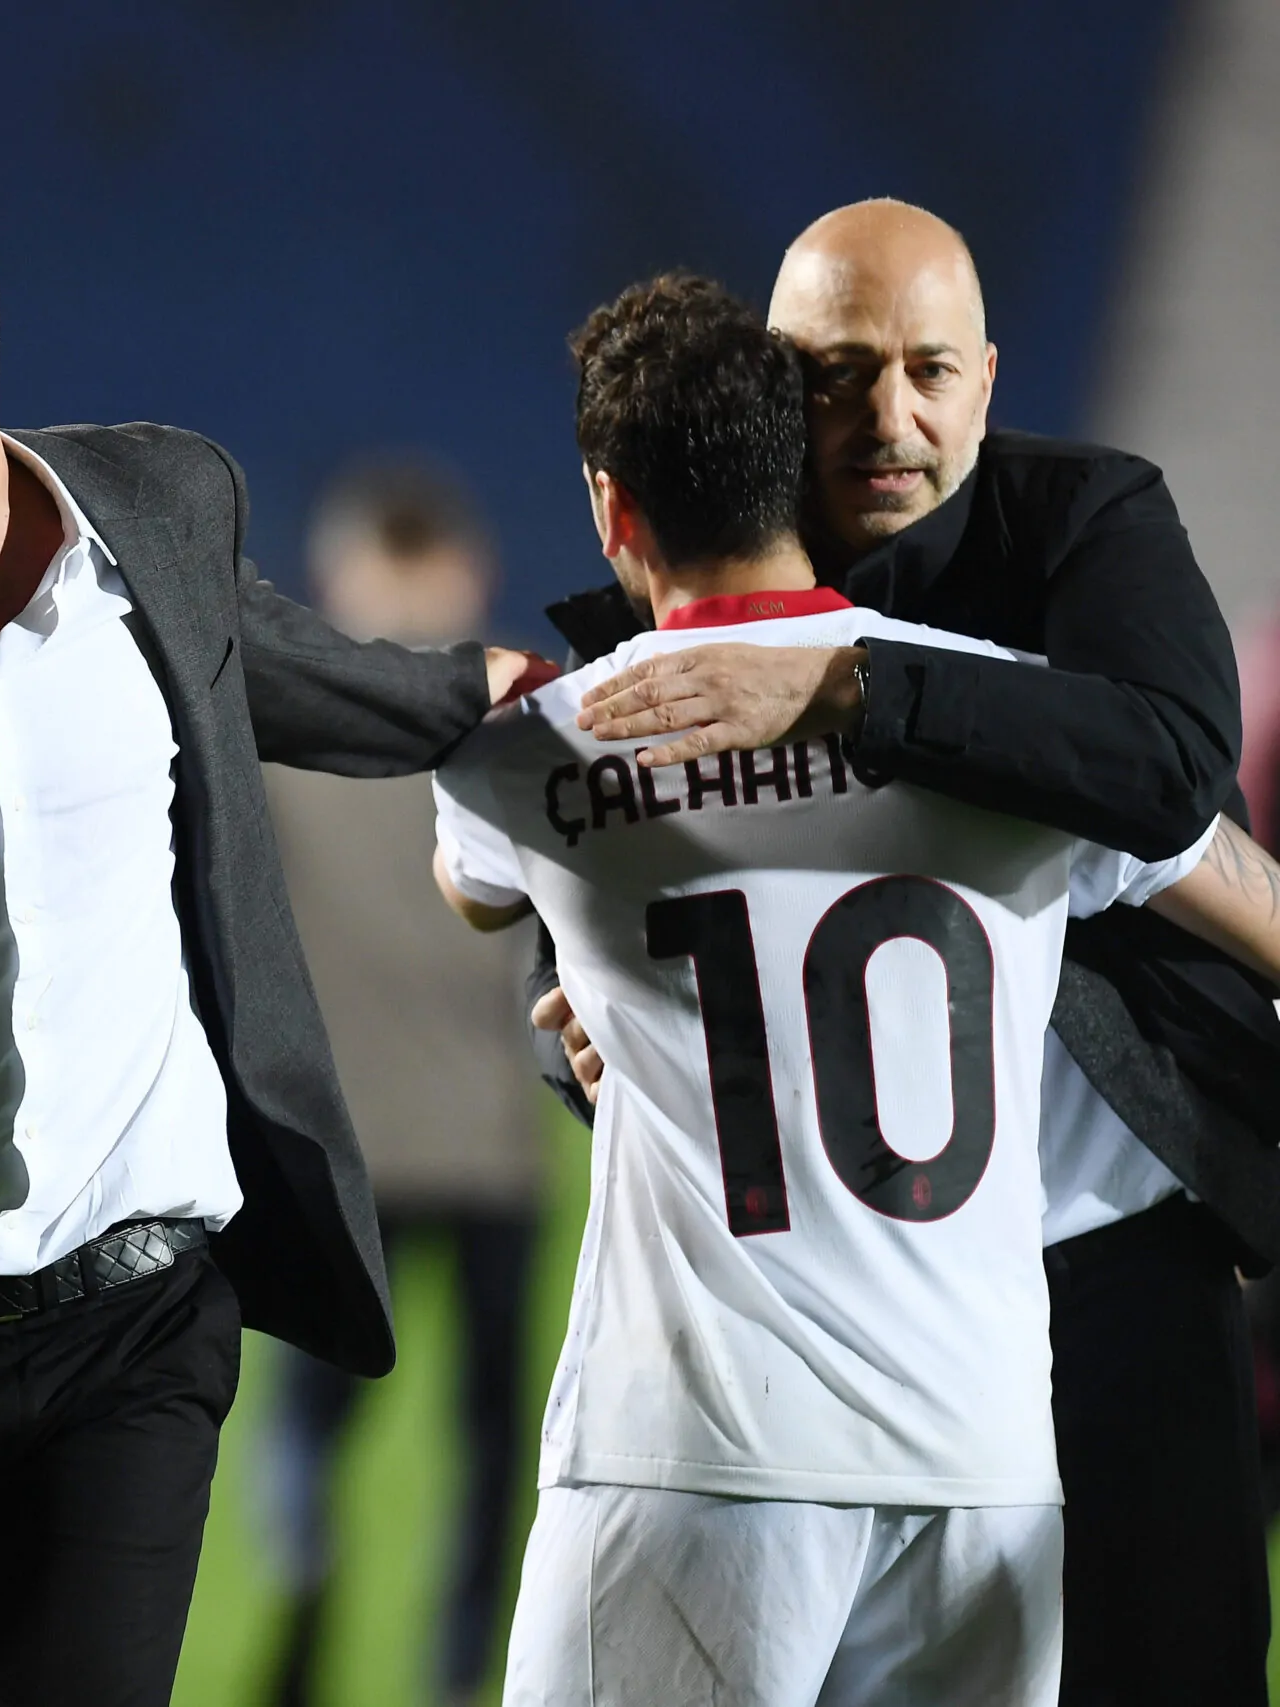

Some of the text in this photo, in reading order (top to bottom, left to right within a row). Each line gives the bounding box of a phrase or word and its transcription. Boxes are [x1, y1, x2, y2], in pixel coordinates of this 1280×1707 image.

[748, 600, 786, 616] ACM
[545, 732, 896, 847] ÇALHAN
[646, 874, 995, 1238] 10
